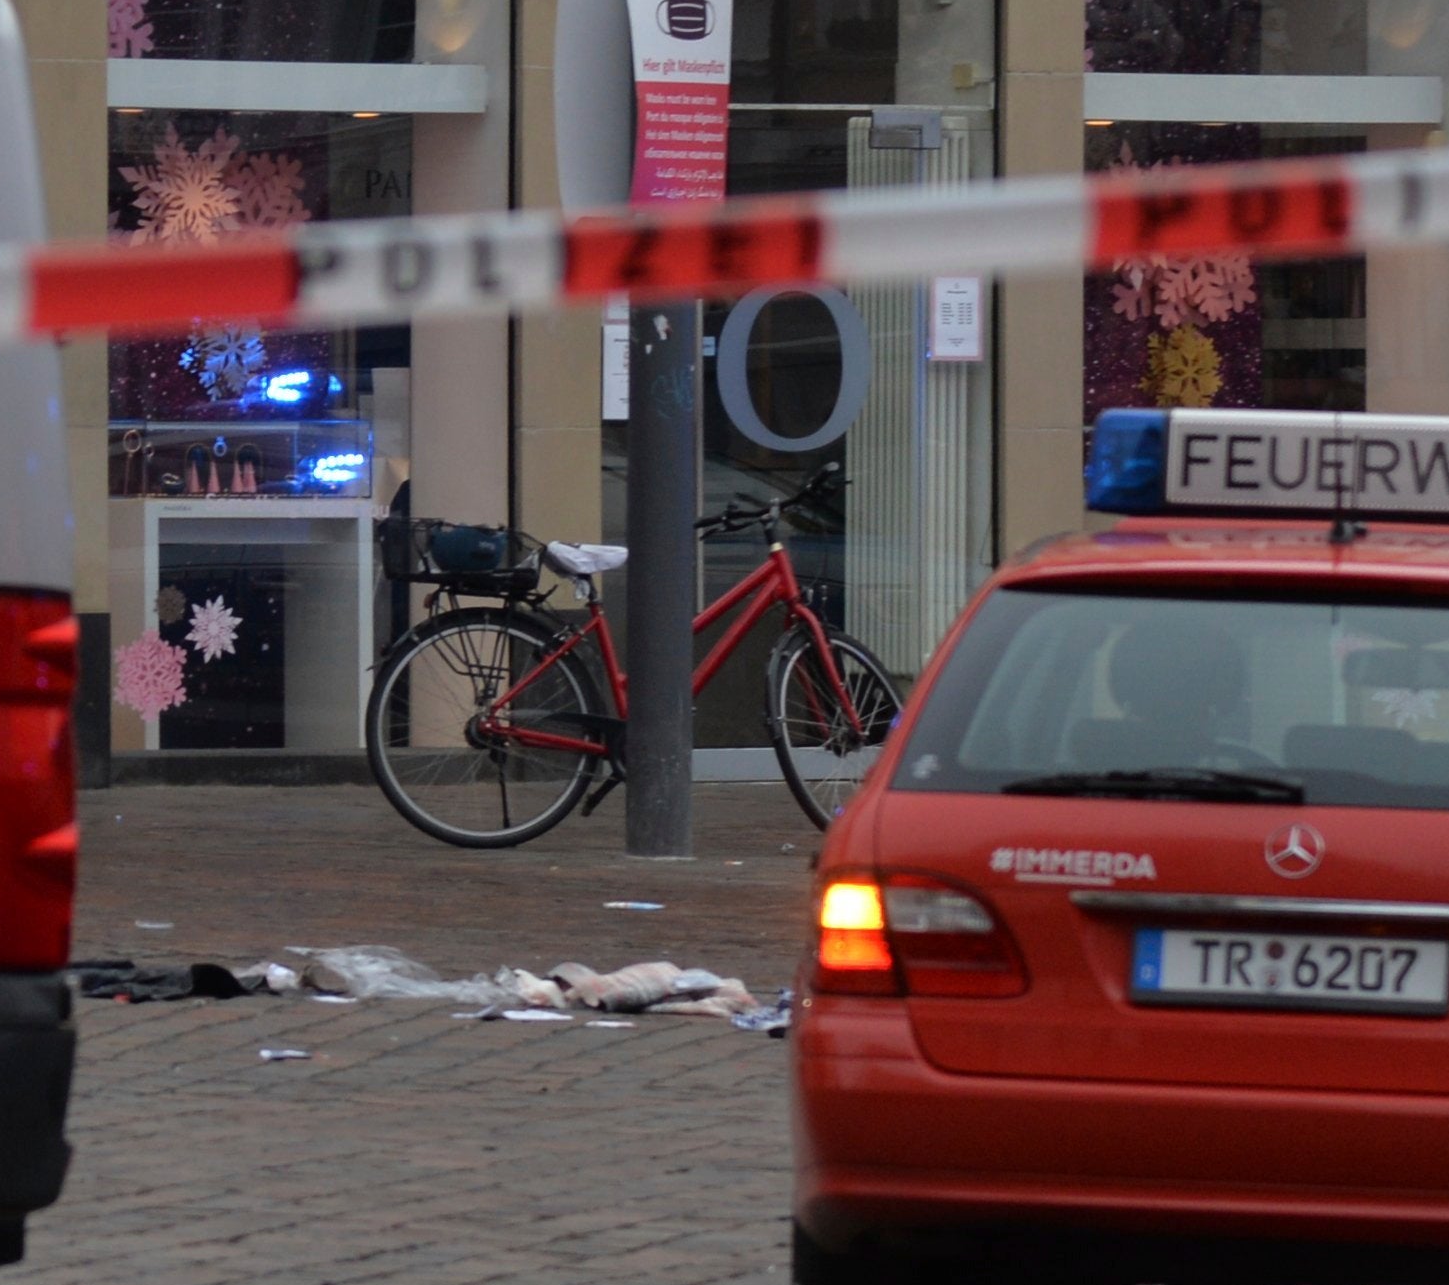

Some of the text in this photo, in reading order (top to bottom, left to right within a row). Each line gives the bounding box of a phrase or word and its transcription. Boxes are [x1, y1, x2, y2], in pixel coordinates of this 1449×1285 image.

[990, 845, 1158, 880] #IMMERDA
[1191, 938, 1419, 993] TR 6207
